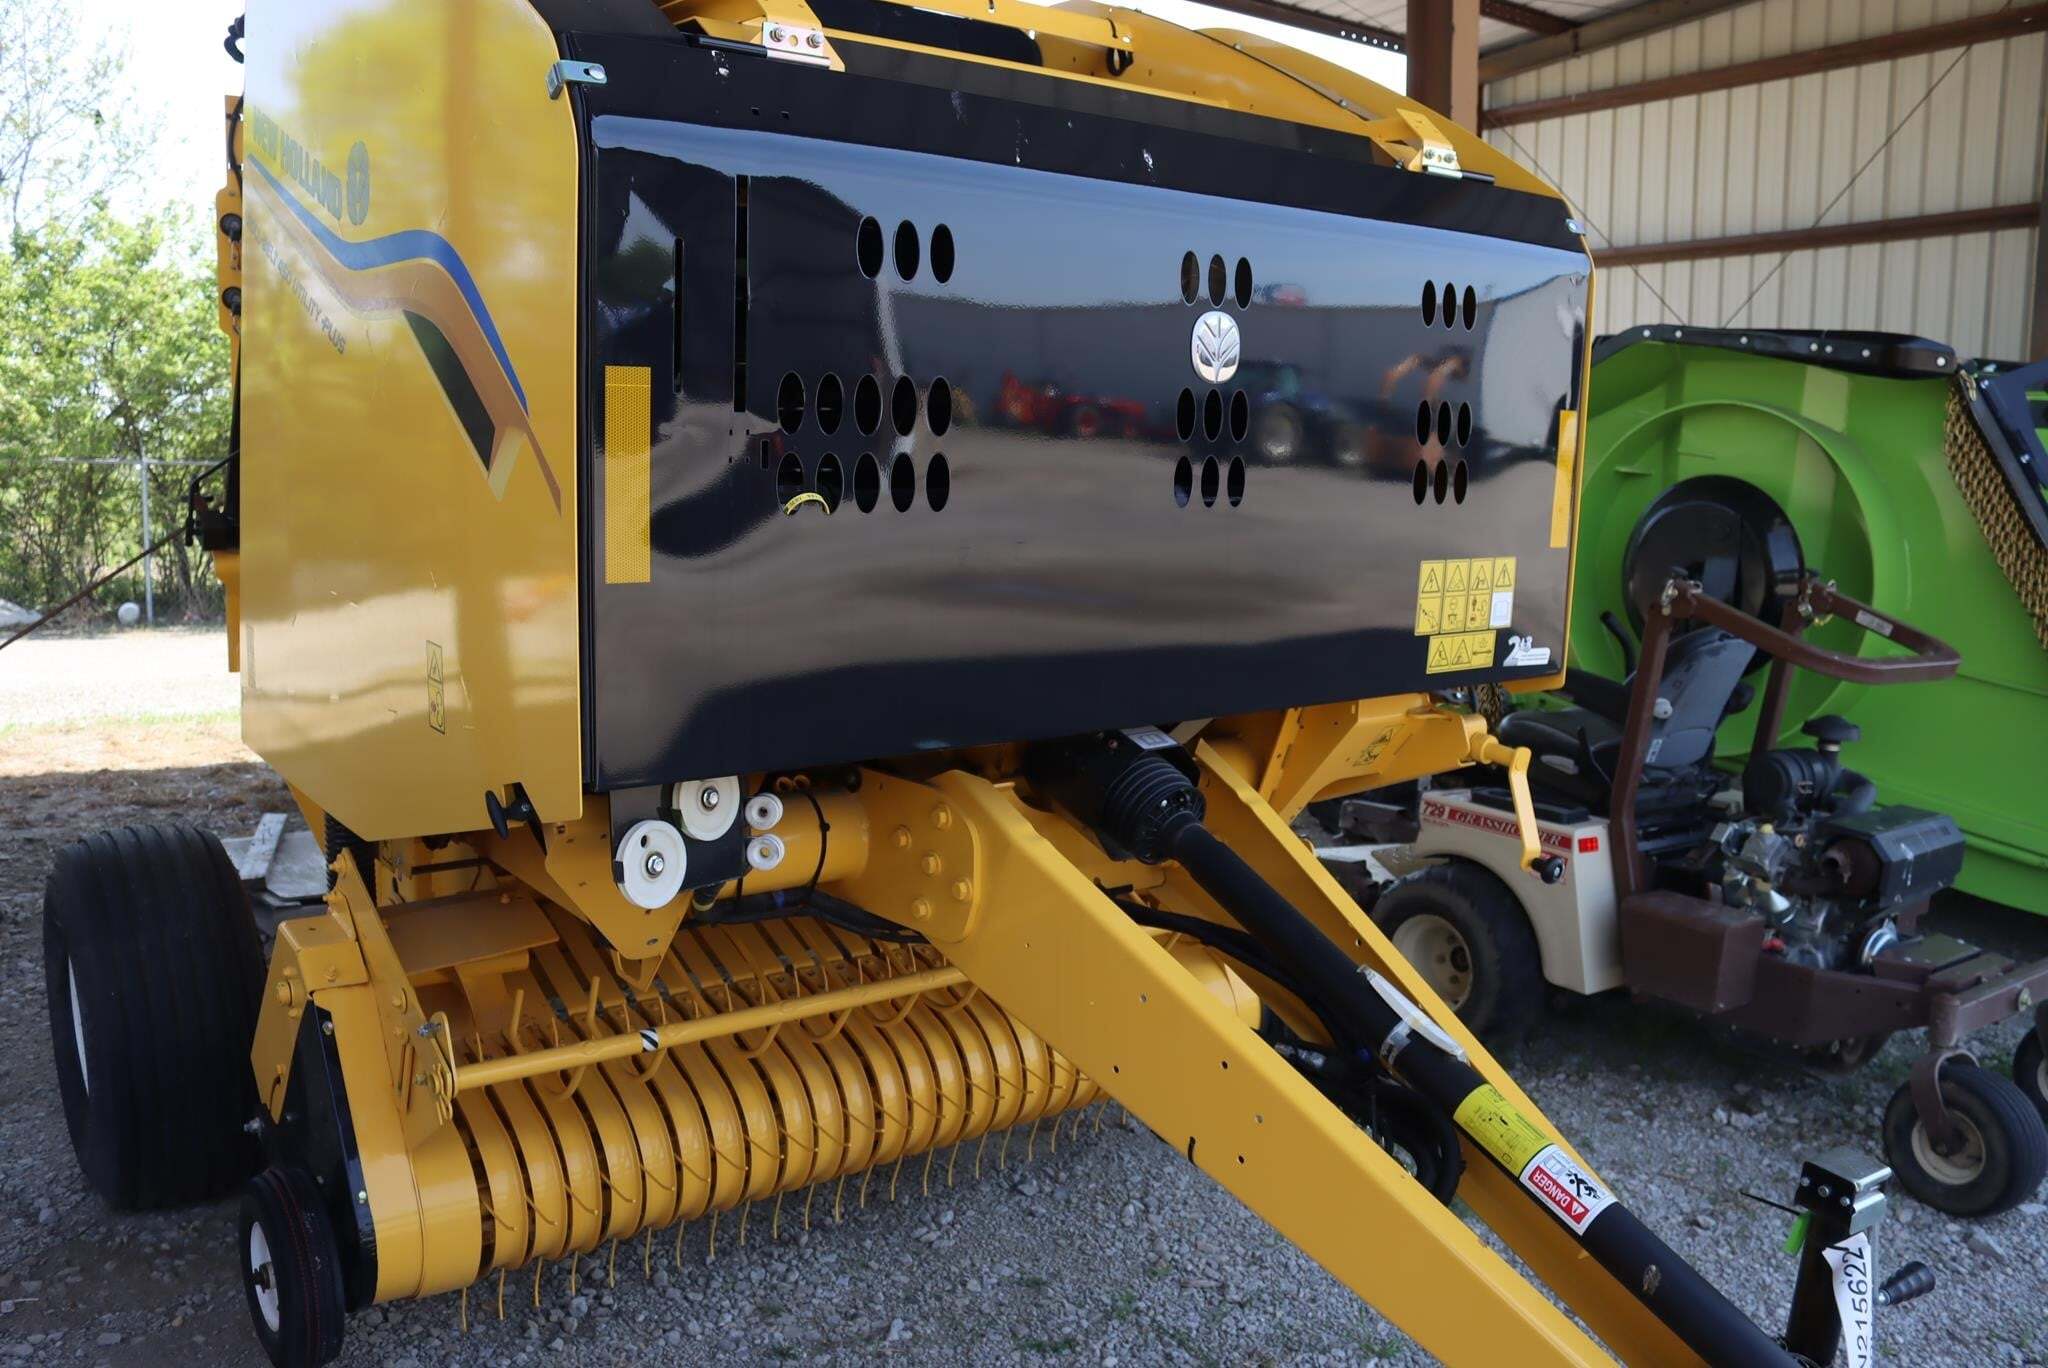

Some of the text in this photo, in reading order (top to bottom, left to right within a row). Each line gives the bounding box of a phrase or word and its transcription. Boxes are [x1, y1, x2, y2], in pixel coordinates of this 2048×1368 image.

[280, 128, 343, 221] HOLLAND
[1423, 802, 1446, 817] 729
[1532, 1170, 1571, 1208] DANGER
